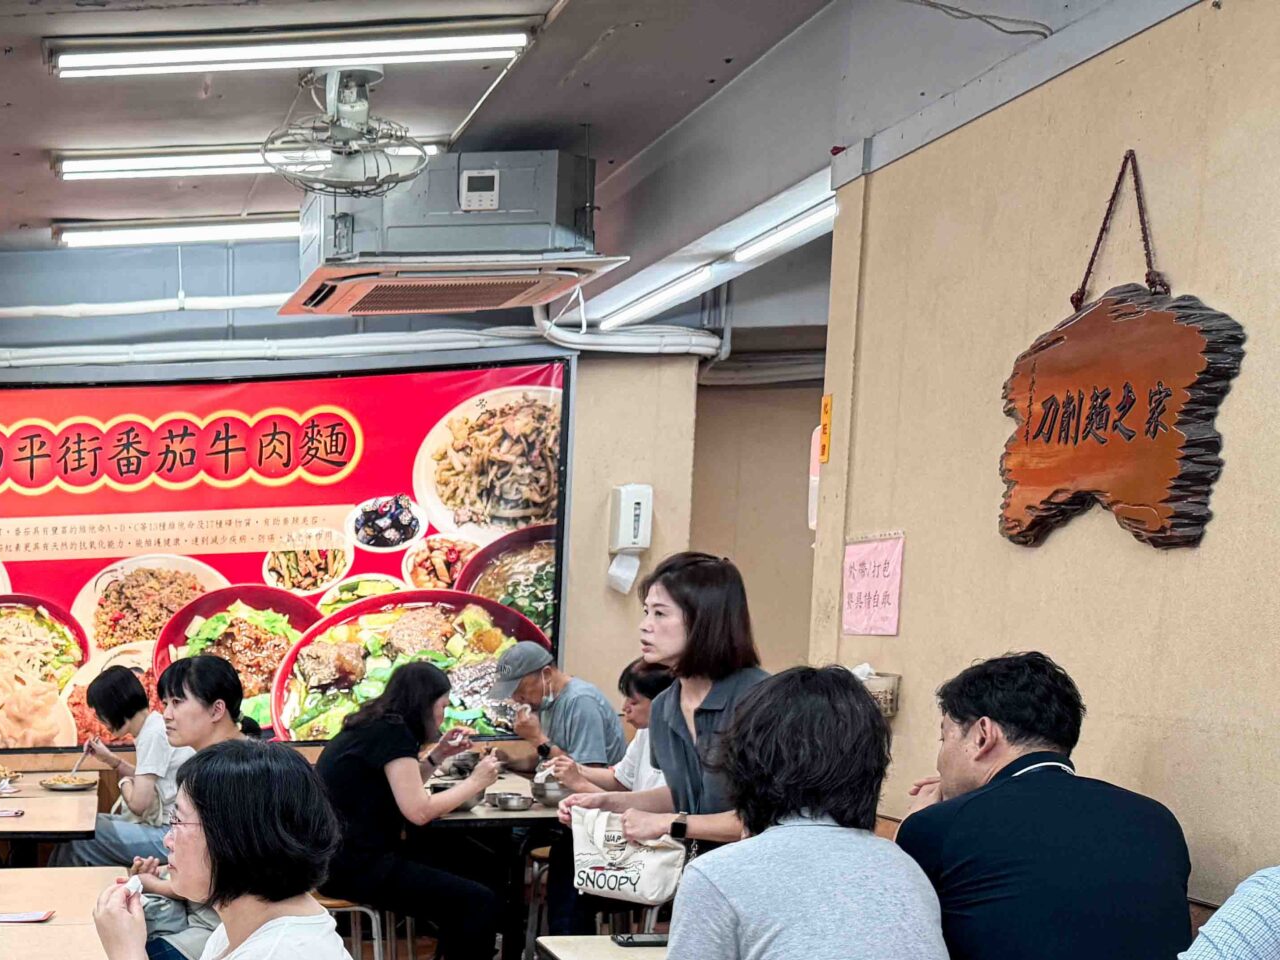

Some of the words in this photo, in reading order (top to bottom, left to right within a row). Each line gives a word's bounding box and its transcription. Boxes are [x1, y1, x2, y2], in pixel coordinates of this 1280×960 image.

[1033, 381, 1172, 446] 刀削麵之家
[577, 870, 641, 892] SNOOPY
